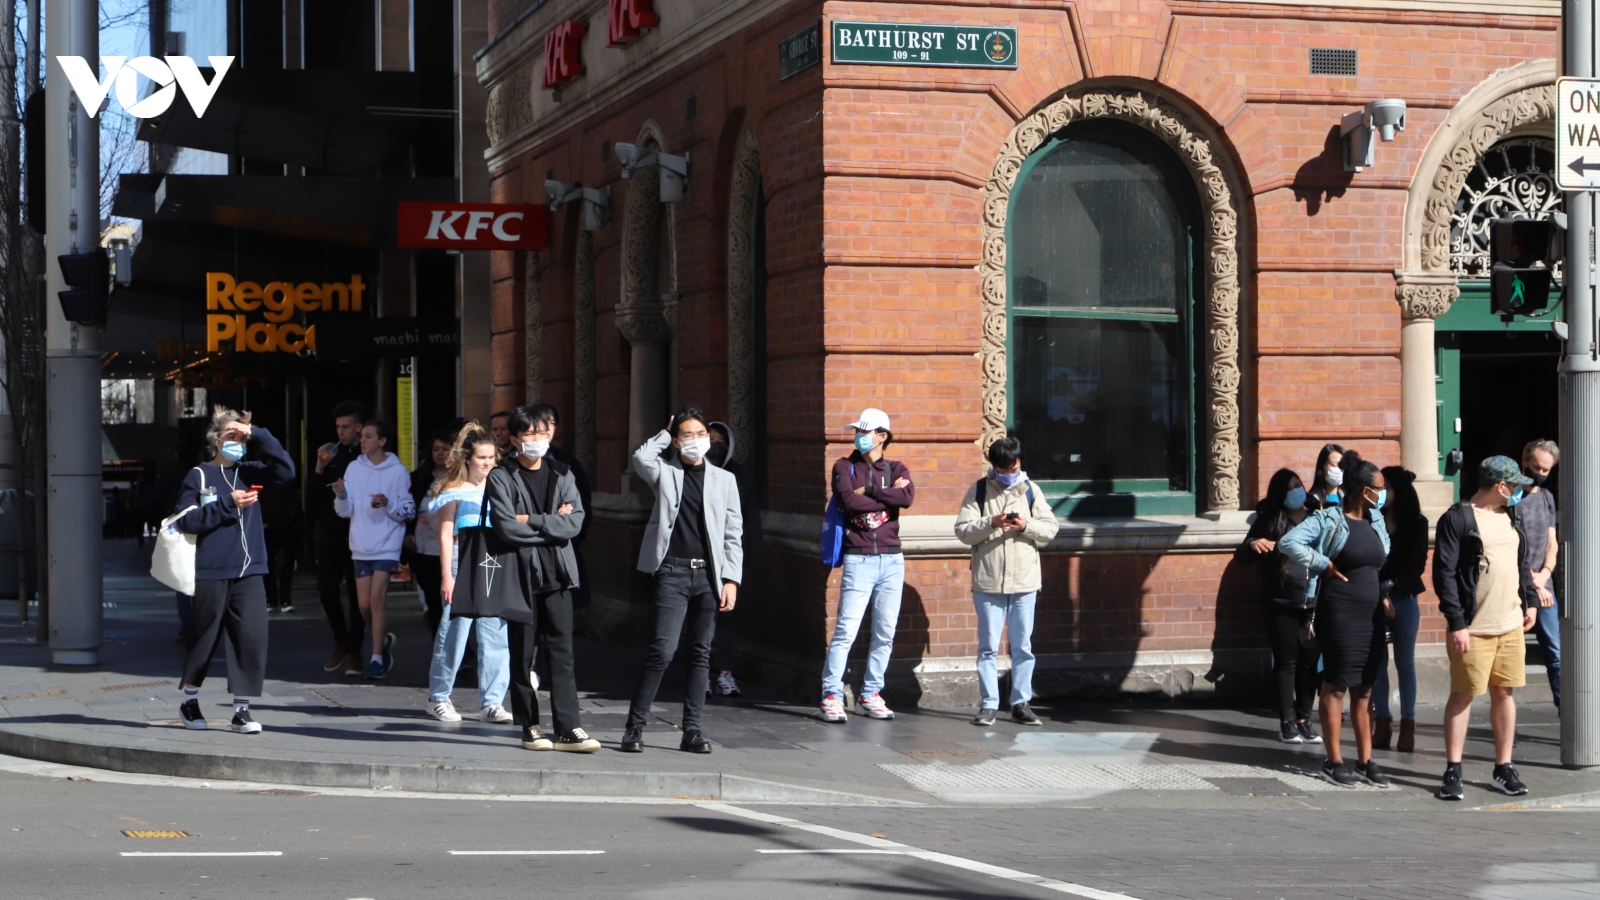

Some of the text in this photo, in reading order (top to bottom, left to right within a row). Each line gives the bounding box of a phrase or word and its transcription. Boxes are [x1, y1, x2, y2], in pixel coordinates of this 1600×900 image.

[839, 28, 980, 51] BATHURST ST
[542, 20, 580, 89] KFC
[892, 50, 908, 60] 109
[920, 51, 930, 61] 91
[1570, 89, 1600, 113] ON
[1568, 123, 1600, 147] WA
[424, 210, 525, 242] KFC
[207, 272, 366, 322] Regent
[373, 328, 420, 346] machi
